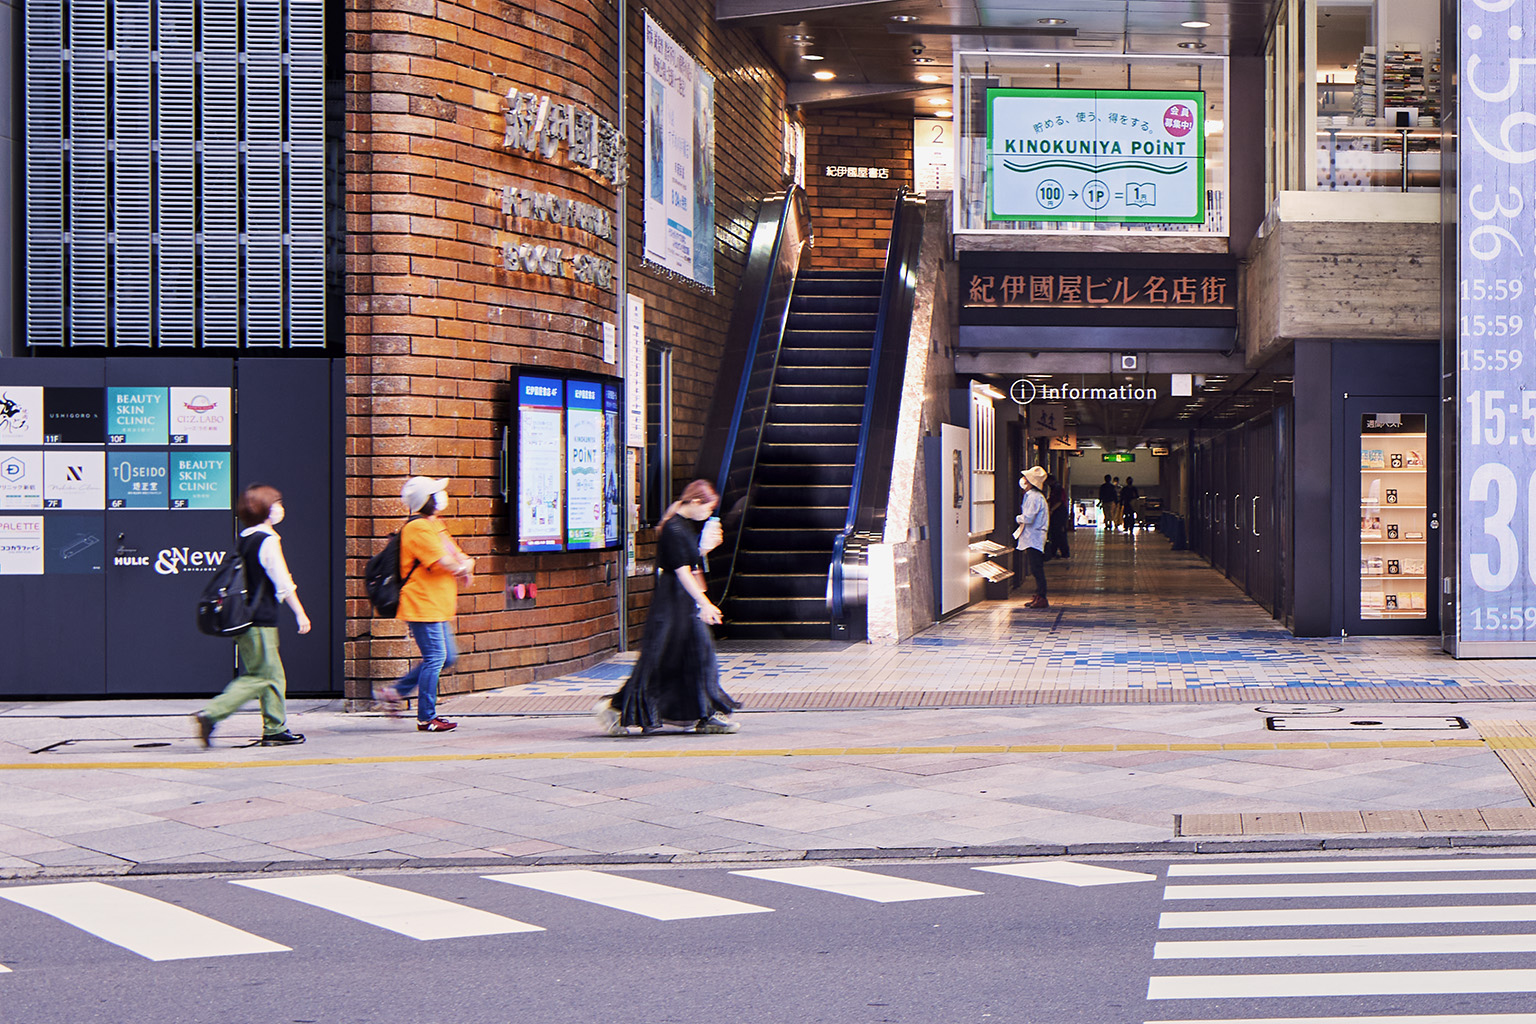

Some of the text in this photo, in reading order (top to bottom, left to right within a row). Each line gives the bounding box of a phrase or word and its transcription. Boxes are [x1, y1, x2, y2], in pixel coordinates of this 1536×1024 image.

[1169, 106, 1190, 118] 会員
[1032, 111, 1154, 134] 貯める、使う、得をする。
[930, 124, 944, 144] 2
[1005, 139, 1122, 155] KINOKUNIYA
[1040, 187, 1061, 200] 100
[969, 274, 1227, 305] 紀伊國屋ビル名店街
[1460, 278, 1523, 302] 15:59
[1460, 314, 1523, 337] 15:59
[1460, 349, 1523, 372] 15:59
[1042, 382, 1157, 401] Information
[116, 394, 161, 404] BEAUTY
[116, 405, 145, 415] SKIN
[116, 416, 156, 425] CLINIC
[46, 435, 59, 443] 11F
[110, 435, 124, 443] 10F
[173, 435, 185, 443] 9F
[179, 460, 224, 470] BEAUTY
[179, 471, 207, 481] SKIN
[179, 482, 218, 491] CLINIC
[112, 500, 123, 508] 6F
[174, 500, 185, 508] 5F
[114, 556, 150, 566] HULIC
